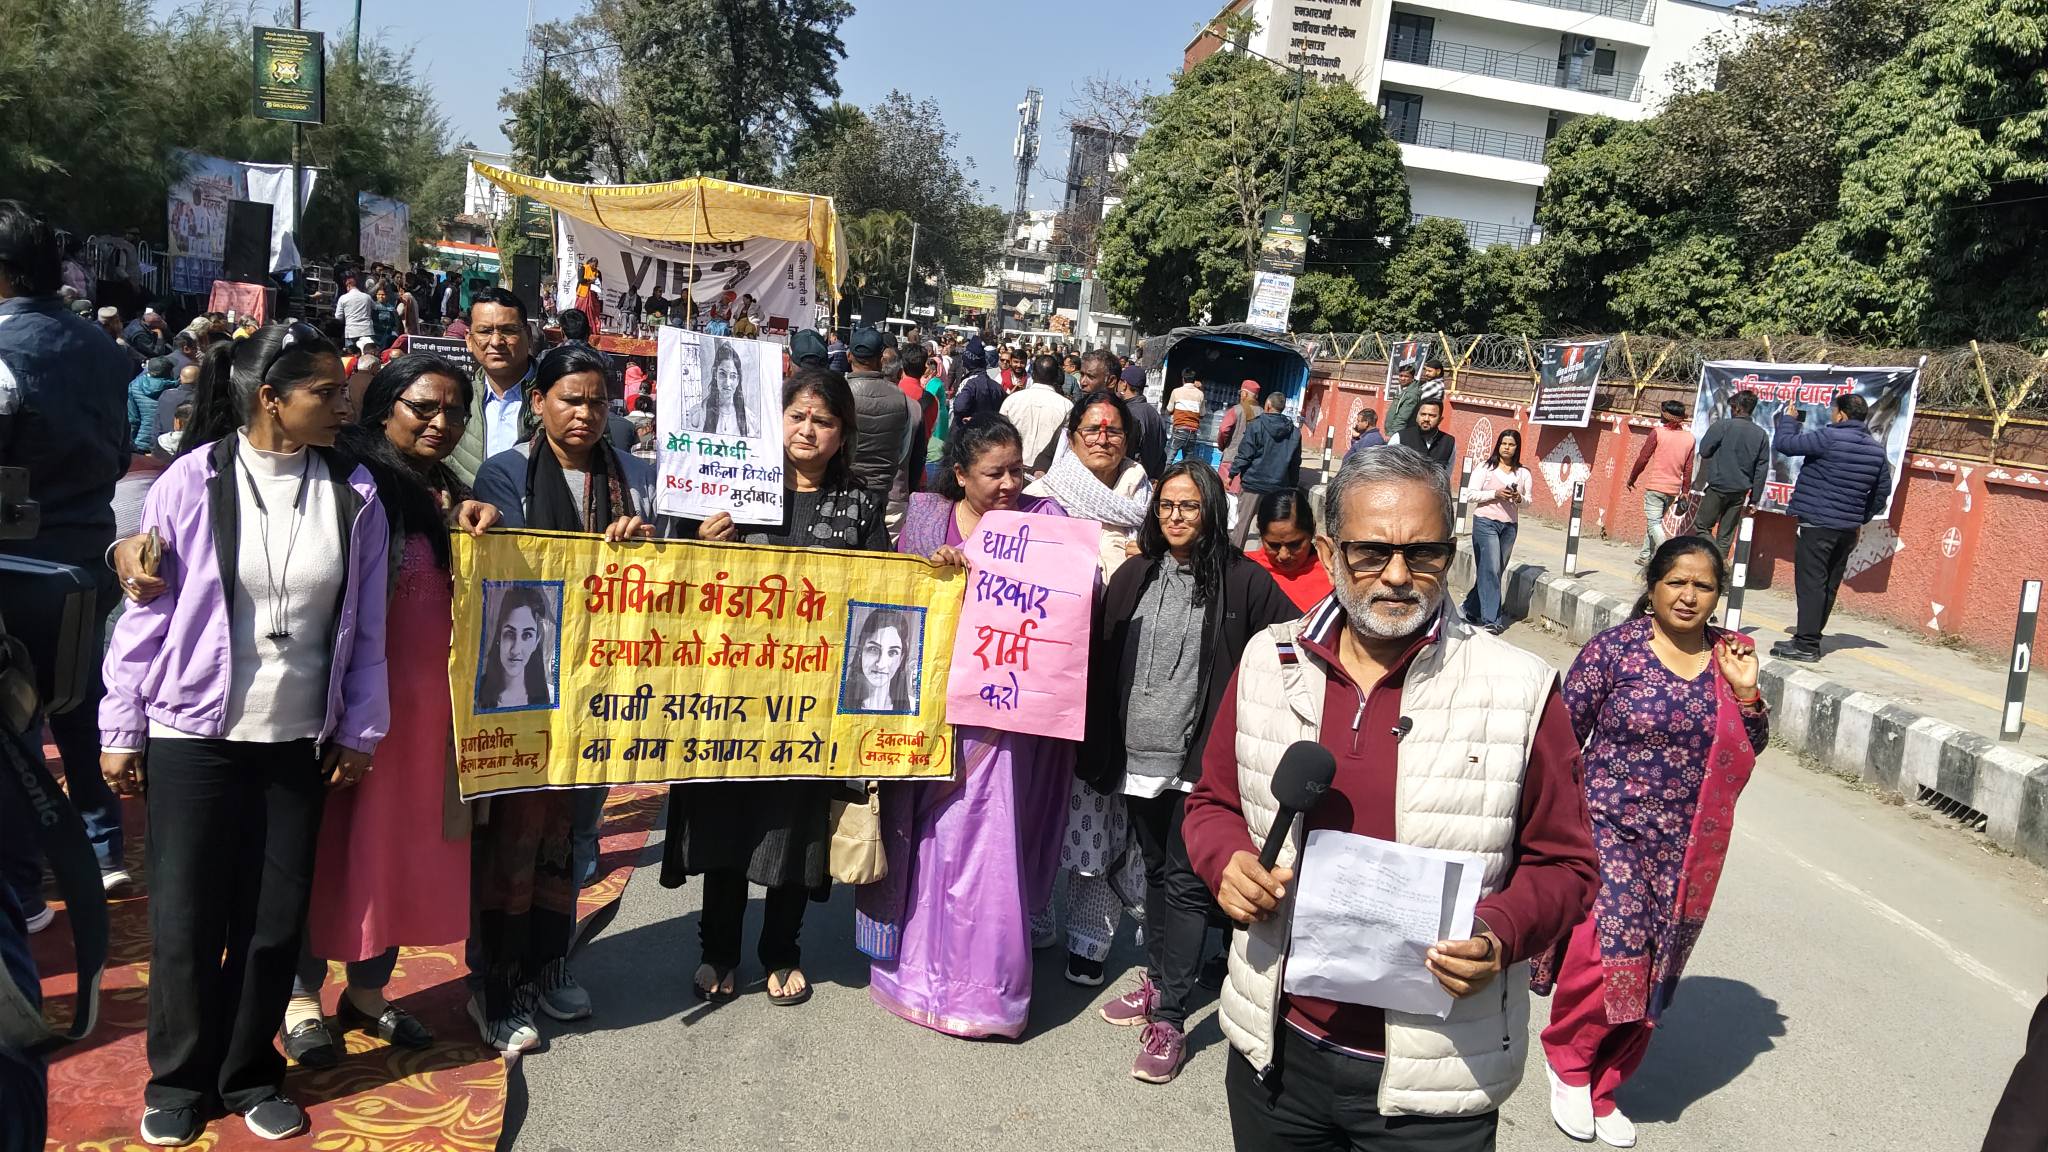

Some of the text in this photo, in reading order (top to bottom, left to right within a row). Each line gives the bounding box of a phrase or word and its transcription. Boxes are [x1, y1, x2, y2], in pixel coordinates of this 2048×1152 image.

[1732, 374, 1775, 402] अंकिता
[1775, 376, 1802, 403] की
[1800, 382, 1833, 406] याद
[667, 432, 751, 460] बेटी विरोधी
[666, 475, 729, 496] RSS-BJP
[699, 461, 783, 483] महिला विरोधी
[983, 524, 1040, 563] धामी
[584, 563, 827, 622] अंकिता भंडारी के
[976, 570, 1055, 619] सरकार
[589, 628, 832, 674] हत्यारों को जेल में डालो
[973, 619, 1046, 671] शर्म
[589, 683, 817, 722] धामी सरकार VIP
[979, 671, 1028, 711] करो
[582, 738, 616, 763] का
[622, 738, 674, 762] नाम
[683, 737, 766, 763] उजागर
